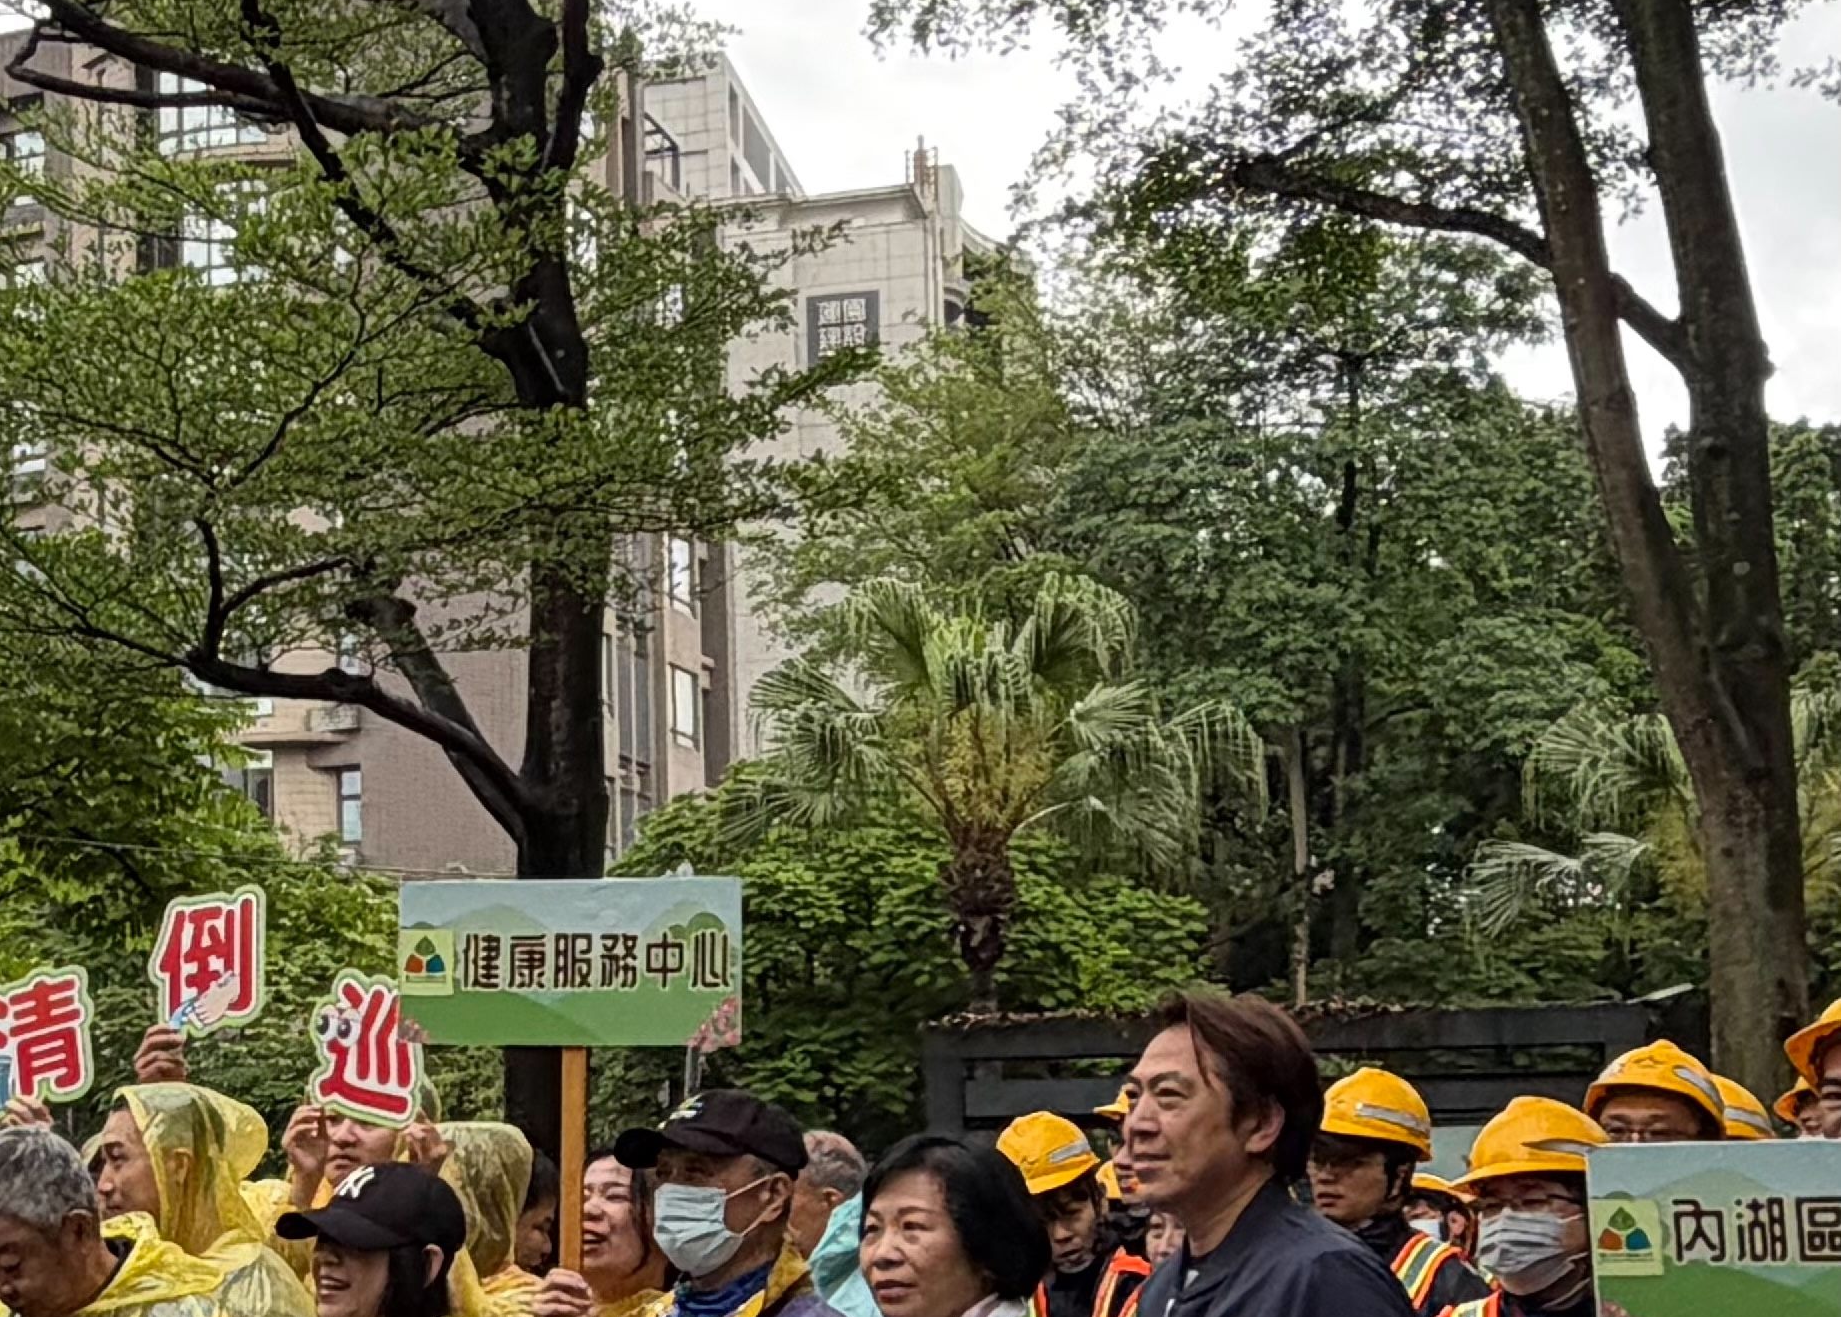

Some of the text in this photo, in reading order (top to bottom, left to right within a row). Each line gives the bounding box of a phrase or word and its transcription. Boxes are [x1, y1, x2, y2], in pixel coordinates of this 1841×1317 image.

[158, 897, 254, 1014] 倒
[462, 932, 731, 989] 健康服務中心
[320, 980, 411, 1115] 巡
[1671, 1196, 1841, 1263] 內湖區
